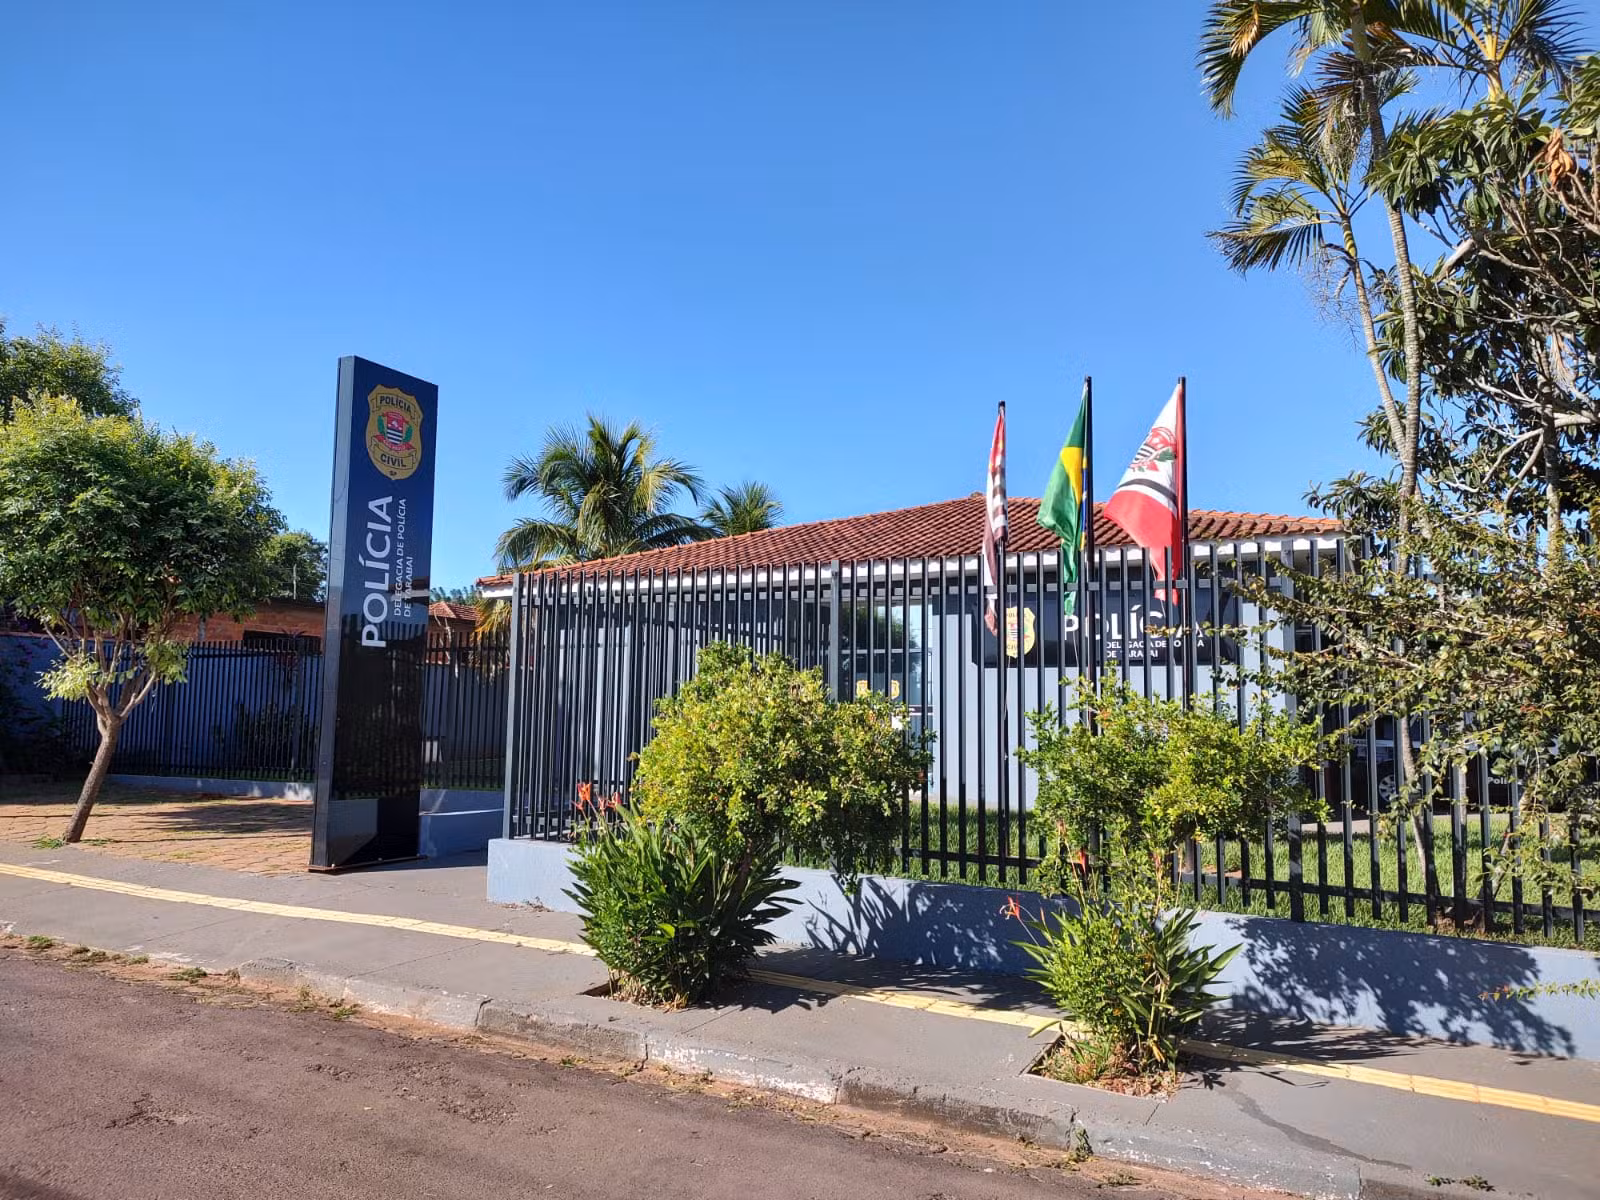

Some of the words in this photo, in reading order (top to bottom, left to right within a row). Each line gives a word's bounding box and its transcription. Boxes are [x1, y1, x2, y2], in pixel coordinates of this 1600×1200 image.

[380, 453, 407, 467] CIVIL
[397, 499, 407, 540] POLÍCIA
[397, 541, 404, 556] DE
[359, 495, 393, 648] POLÍCIA
[394, 558, 404, 616] DELEGACIA
[405, 556, 414, 600] TARABAI
[404, 602, 412, 617] DE
